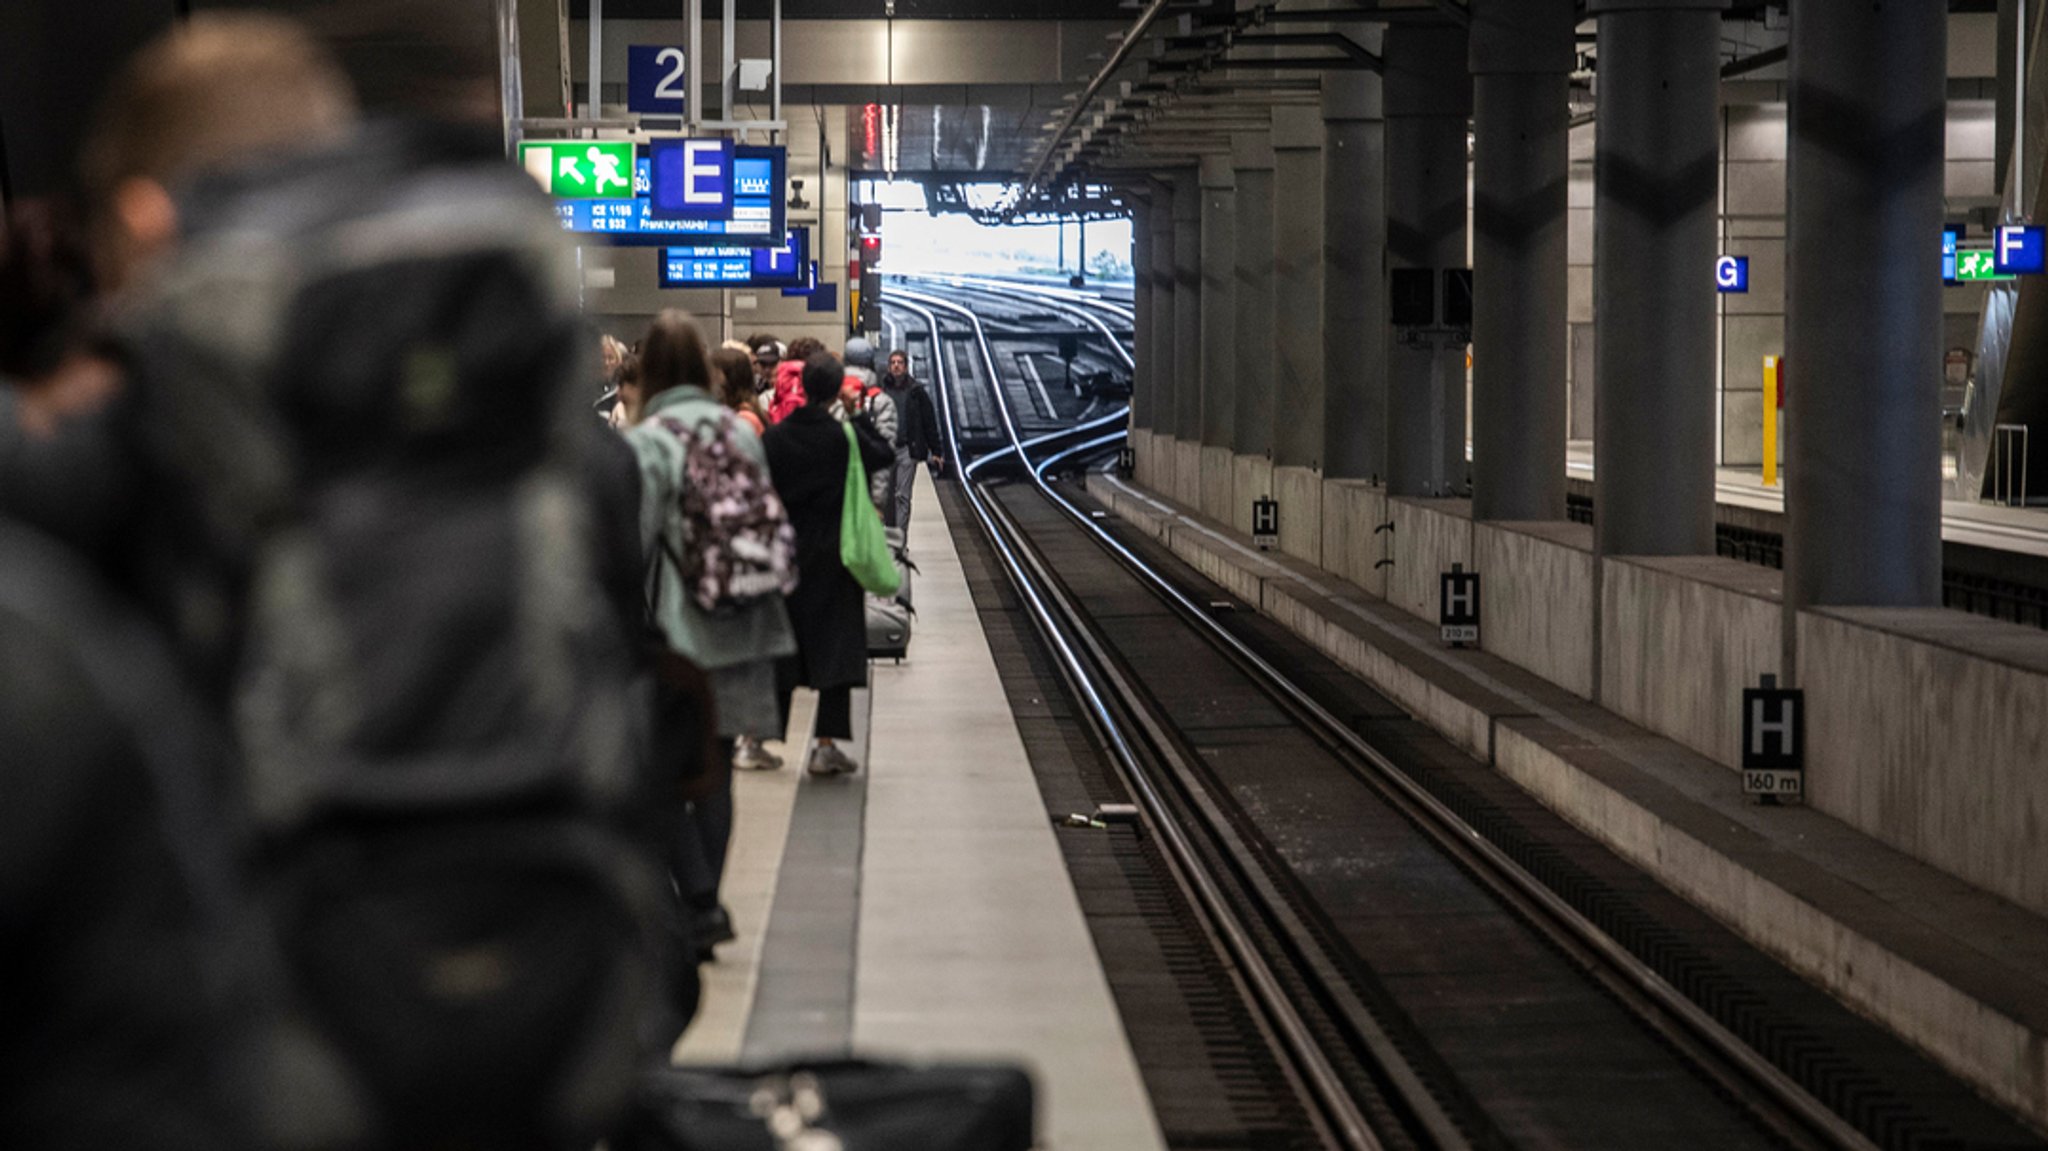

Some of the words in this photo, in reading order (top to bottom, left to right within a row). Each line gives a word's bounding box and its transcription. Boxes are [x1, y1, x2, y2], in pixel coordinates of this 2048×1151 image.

[655, 48, 685, 98] 2
[684, 140, 723, 203] E
[2001, 226, 2025, 265] F
[1716, 256, 1737, 286] G
[1120, 450, 1133, 466] H
[1257, 504, 1275, 530] H
[1447, 579, 1473, 616] H
[1752, 699, 1793, 755] H
[1747, 772, 1775, 790] 160
[1780, 777, 1798, 790] m
